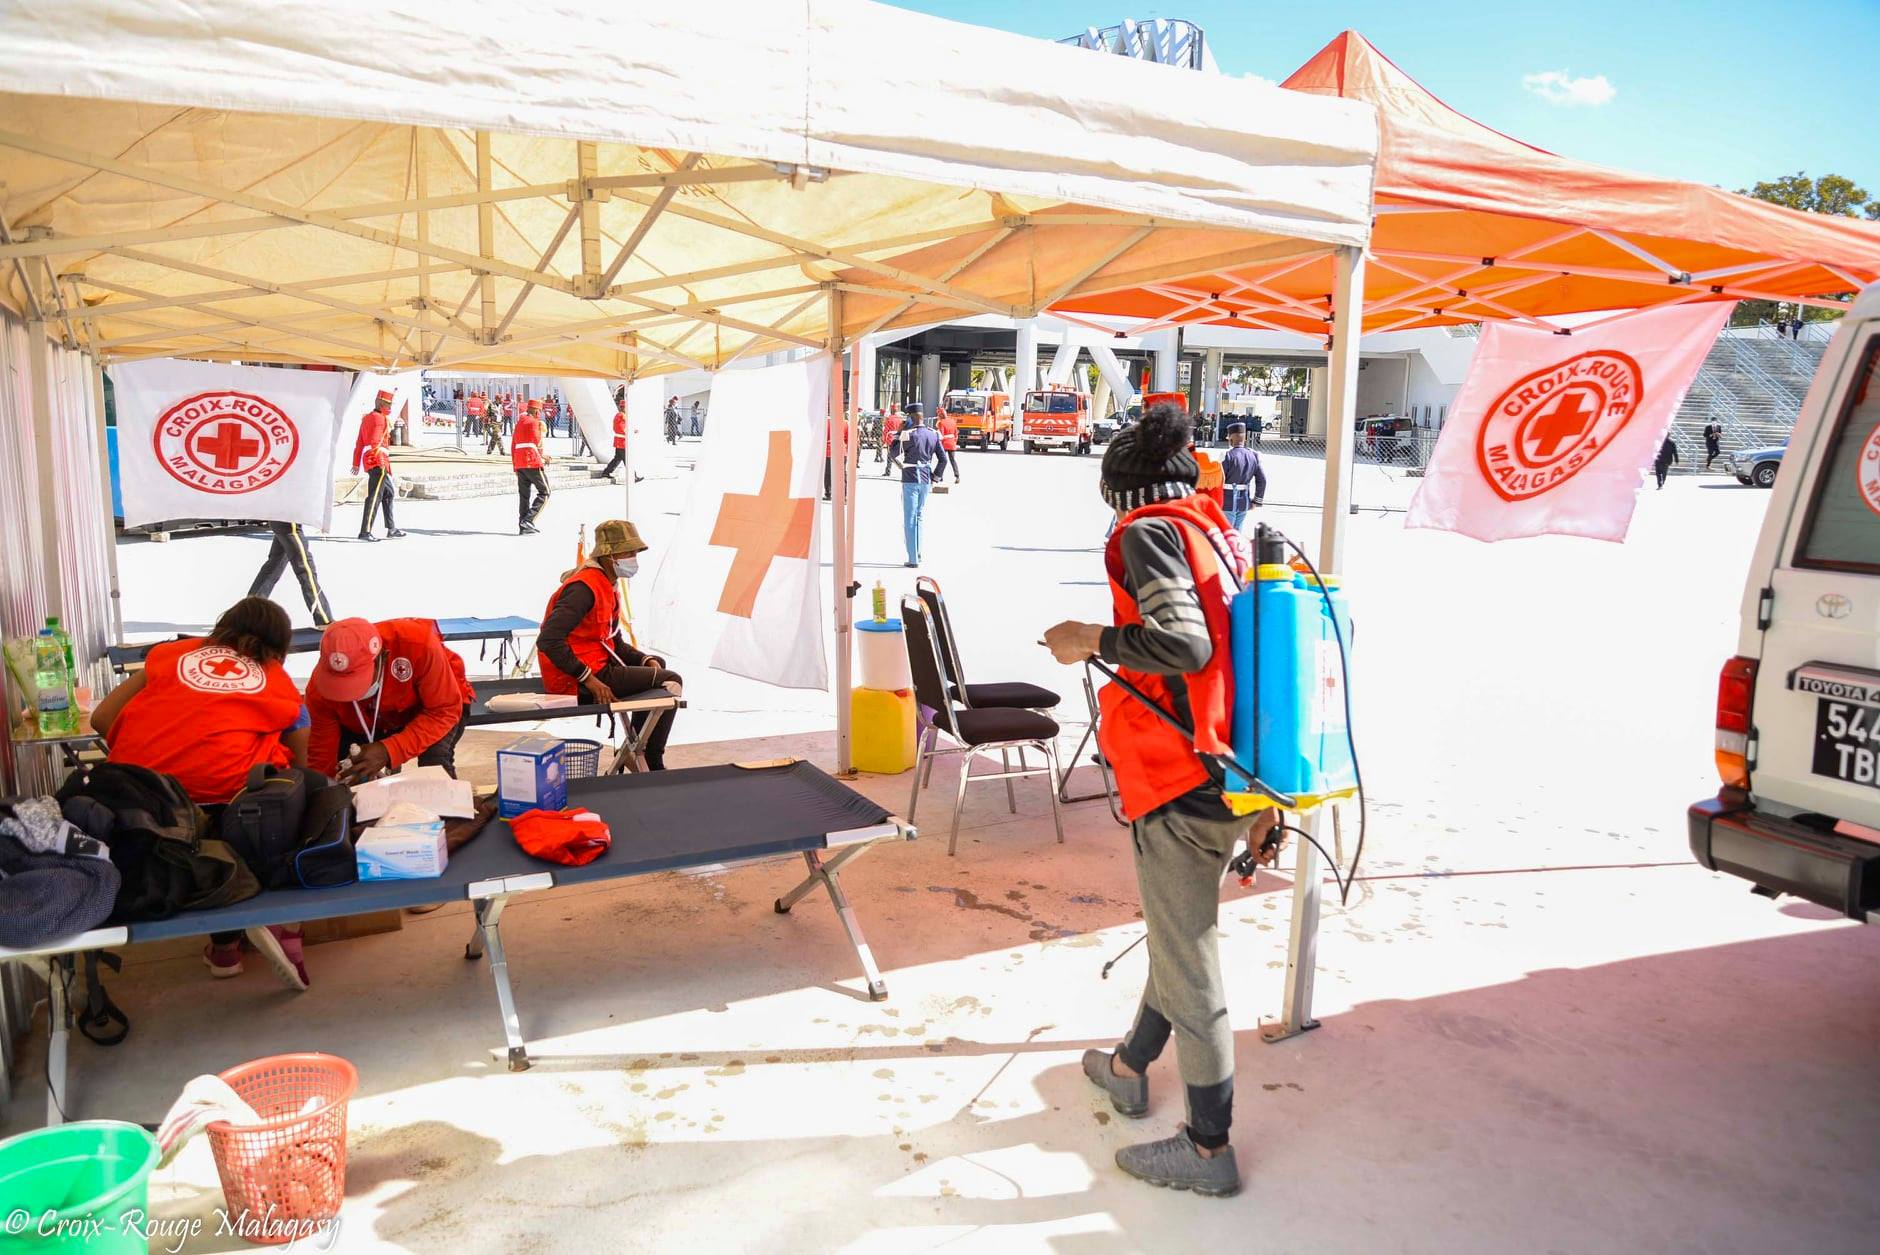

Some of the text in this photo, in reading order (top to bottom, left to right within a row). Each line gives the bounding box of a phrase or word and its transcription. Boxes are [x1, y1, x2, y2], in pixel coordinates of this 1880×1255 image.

[1503, 360, 1630, 417] CROIX-ROUGE
[166, 399, 290, 445] CROIX-ROUGE
[169, 455, 284, 490] MALAGASY
[1488, 436, 1599, 491] MALAGASY
[188, 667, 246, 689] MALAGASY
[1802, 678, 1864, 701] TOYOTA
[1834, 742, 1880, 786] TB
